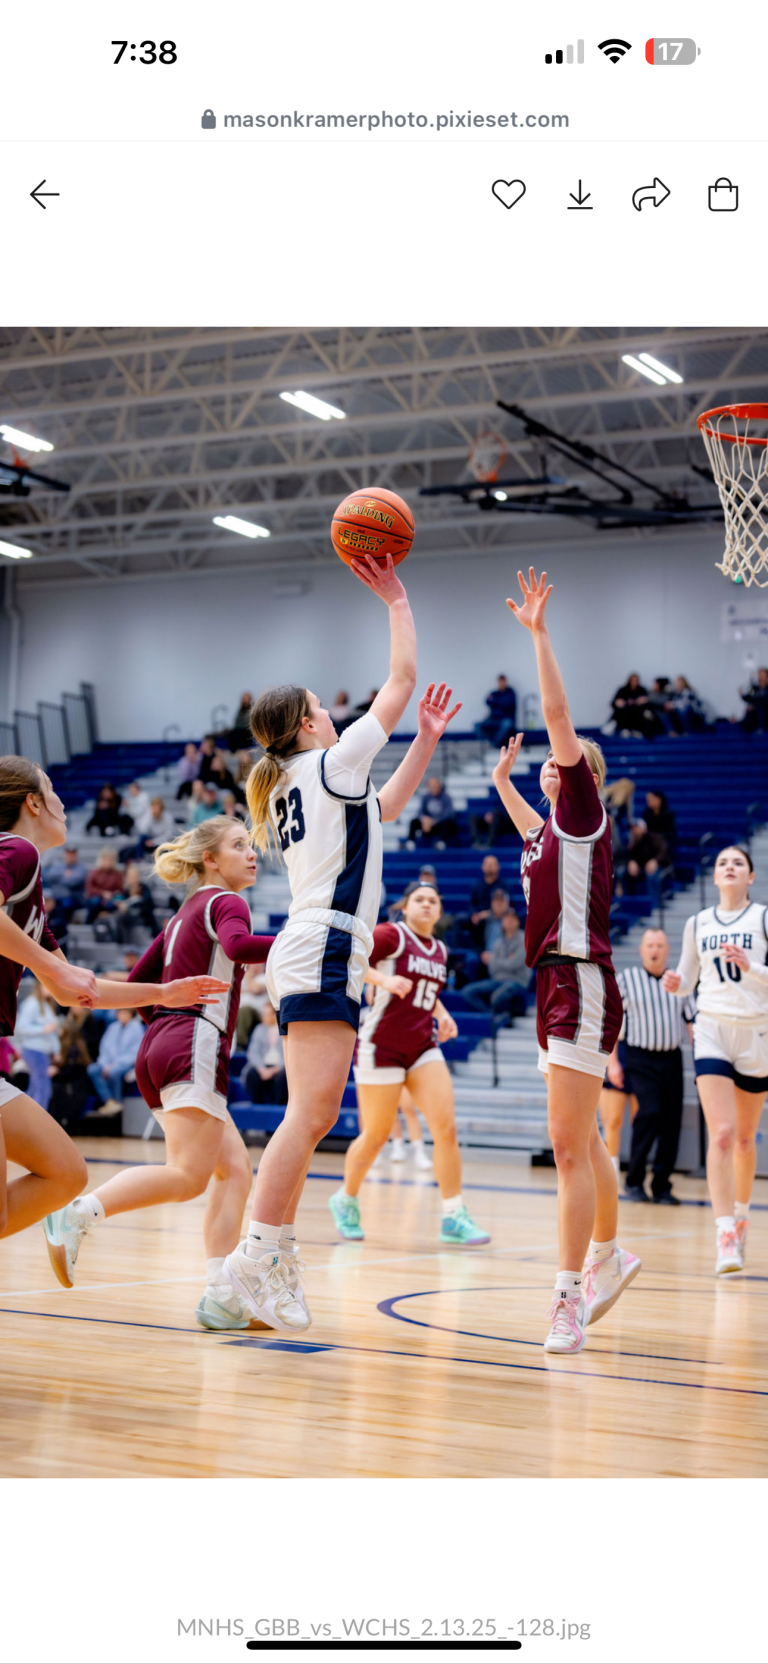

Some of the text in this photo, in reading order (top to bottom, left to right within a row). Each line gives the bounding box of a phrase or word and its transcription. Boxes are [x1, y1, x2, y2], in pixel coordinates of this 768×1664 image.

[341, 503, 395, 529] SPALDING
[338, 526, 386, 546] LEGACY
[275, 786, 306, 852] 23
[701, 932, 753, 953] NORTH
[713, 956, 742, 983] 10
[412, 979, 440, 1011] 15
